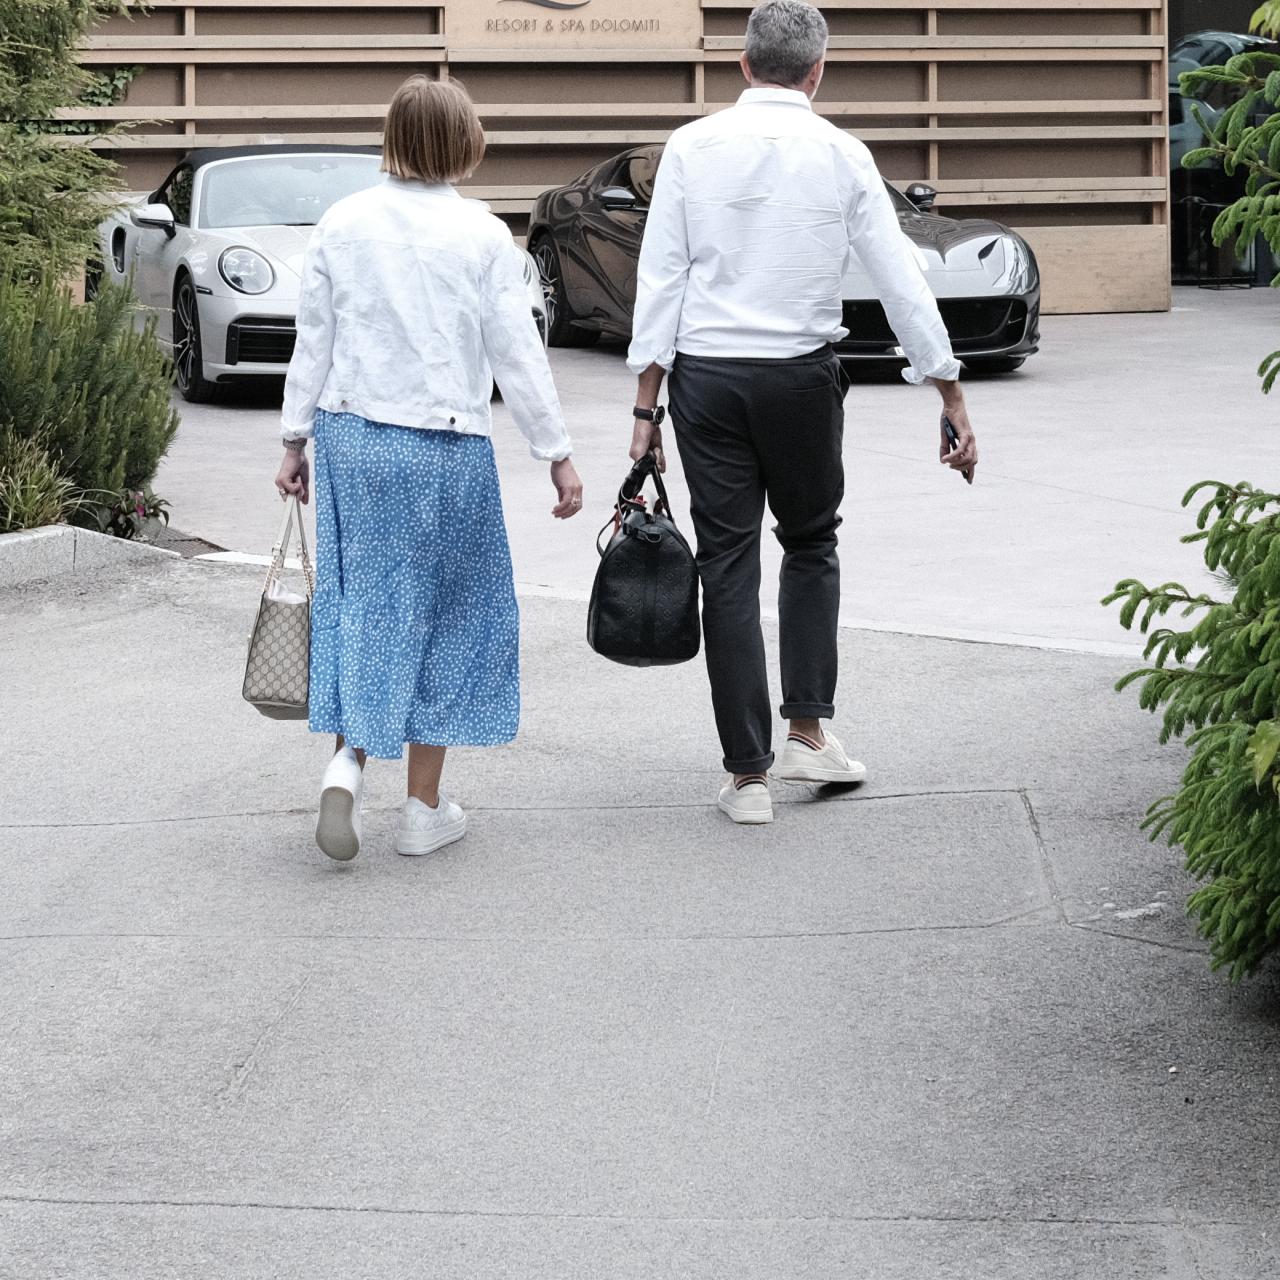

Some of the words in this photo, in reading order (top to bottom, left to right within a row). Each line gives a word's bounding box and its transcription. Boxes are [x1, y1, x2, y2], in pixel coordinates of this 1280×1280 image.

[485, 18, 538, 32] RESORT
[544, 18, 554, 32] &
[560, 18, 585, 32] SPA
[590, 18, 660, 32] DOLOMITI
